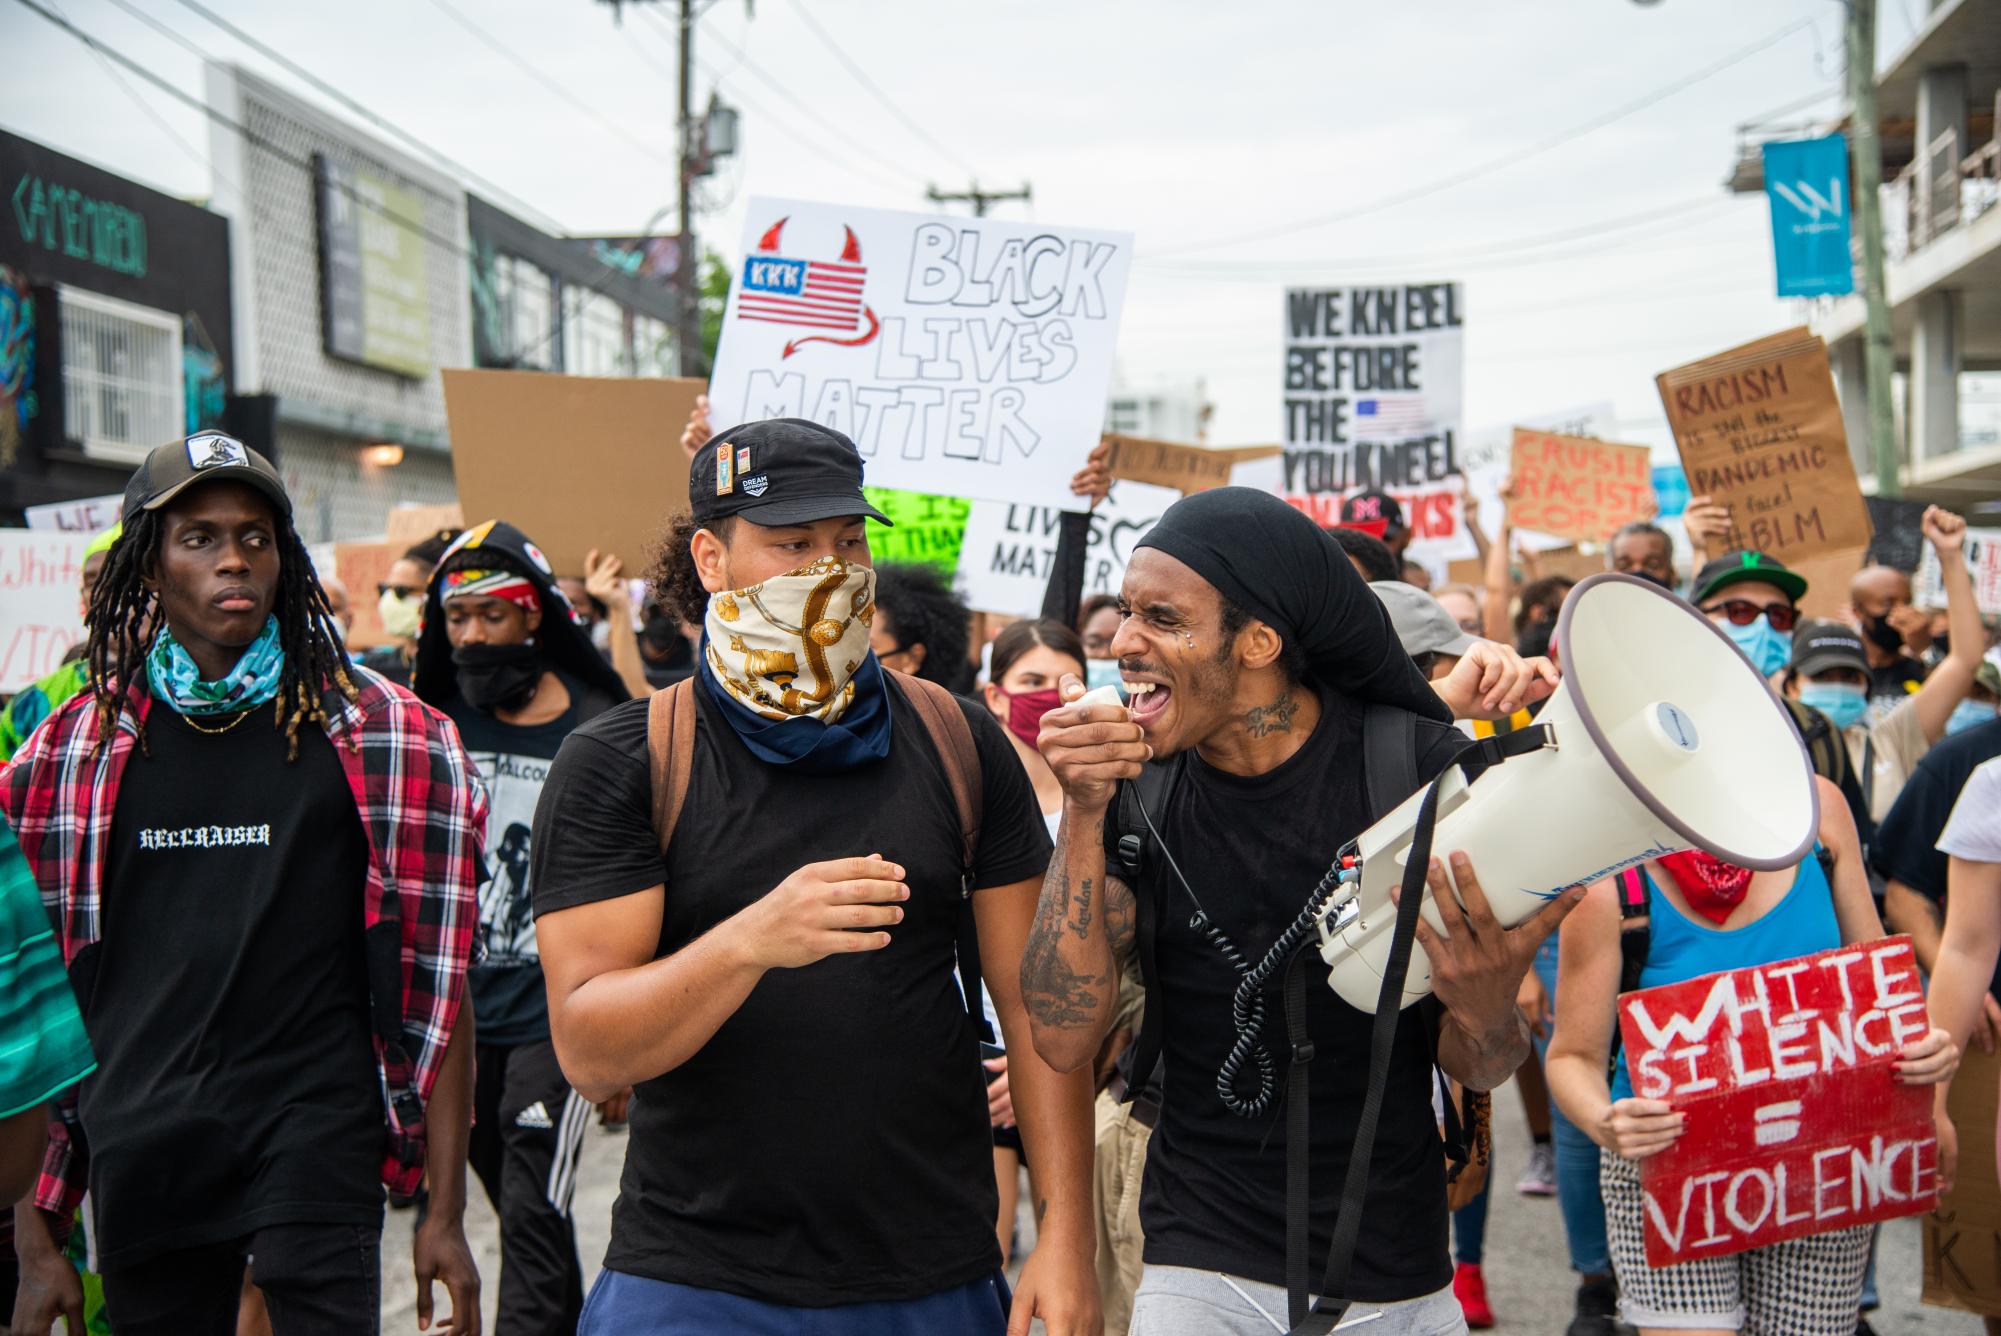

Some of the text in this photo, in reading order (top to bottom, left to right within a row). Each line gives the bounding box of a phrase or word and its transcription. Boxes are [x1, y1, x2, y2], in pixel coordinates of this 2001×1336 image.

[751, 261, 800, 289] KKK
[904, 223, 1117, 319] BLACK
[1289, 282, 1463, 338] WE KNEEL
[875, 317, 1078, 384] LIVES
[1286, 344, 1420, 391] BEFORE
[1674, 363, 1789, 419] RACISM
[741, 369, 1041, 464] MATTER
[1285, 398, 1348, 443] THE
[1284, 448, 1348, 493] YOU
[1355, 431, 1462, 492] KNEEL
[1515, 433, 1646, 480] CRUSH
[1695, 446, 1827, 493] PANDEMIC
[743, 476, 768, 487] DREAM
[1517, 464, 1648, 513] RACIST
[1005, 503, 1108, 546] LIVS
[1352, 497, 1381, 521] M
[139, 823, 271, 850] HELLRAISER
[1627, 944, 1920, 1050] WHITE
[1638, 1003, 1927, 1099] SILENCE
[1645, 1136, 1937, 1253] VIOLENCE
